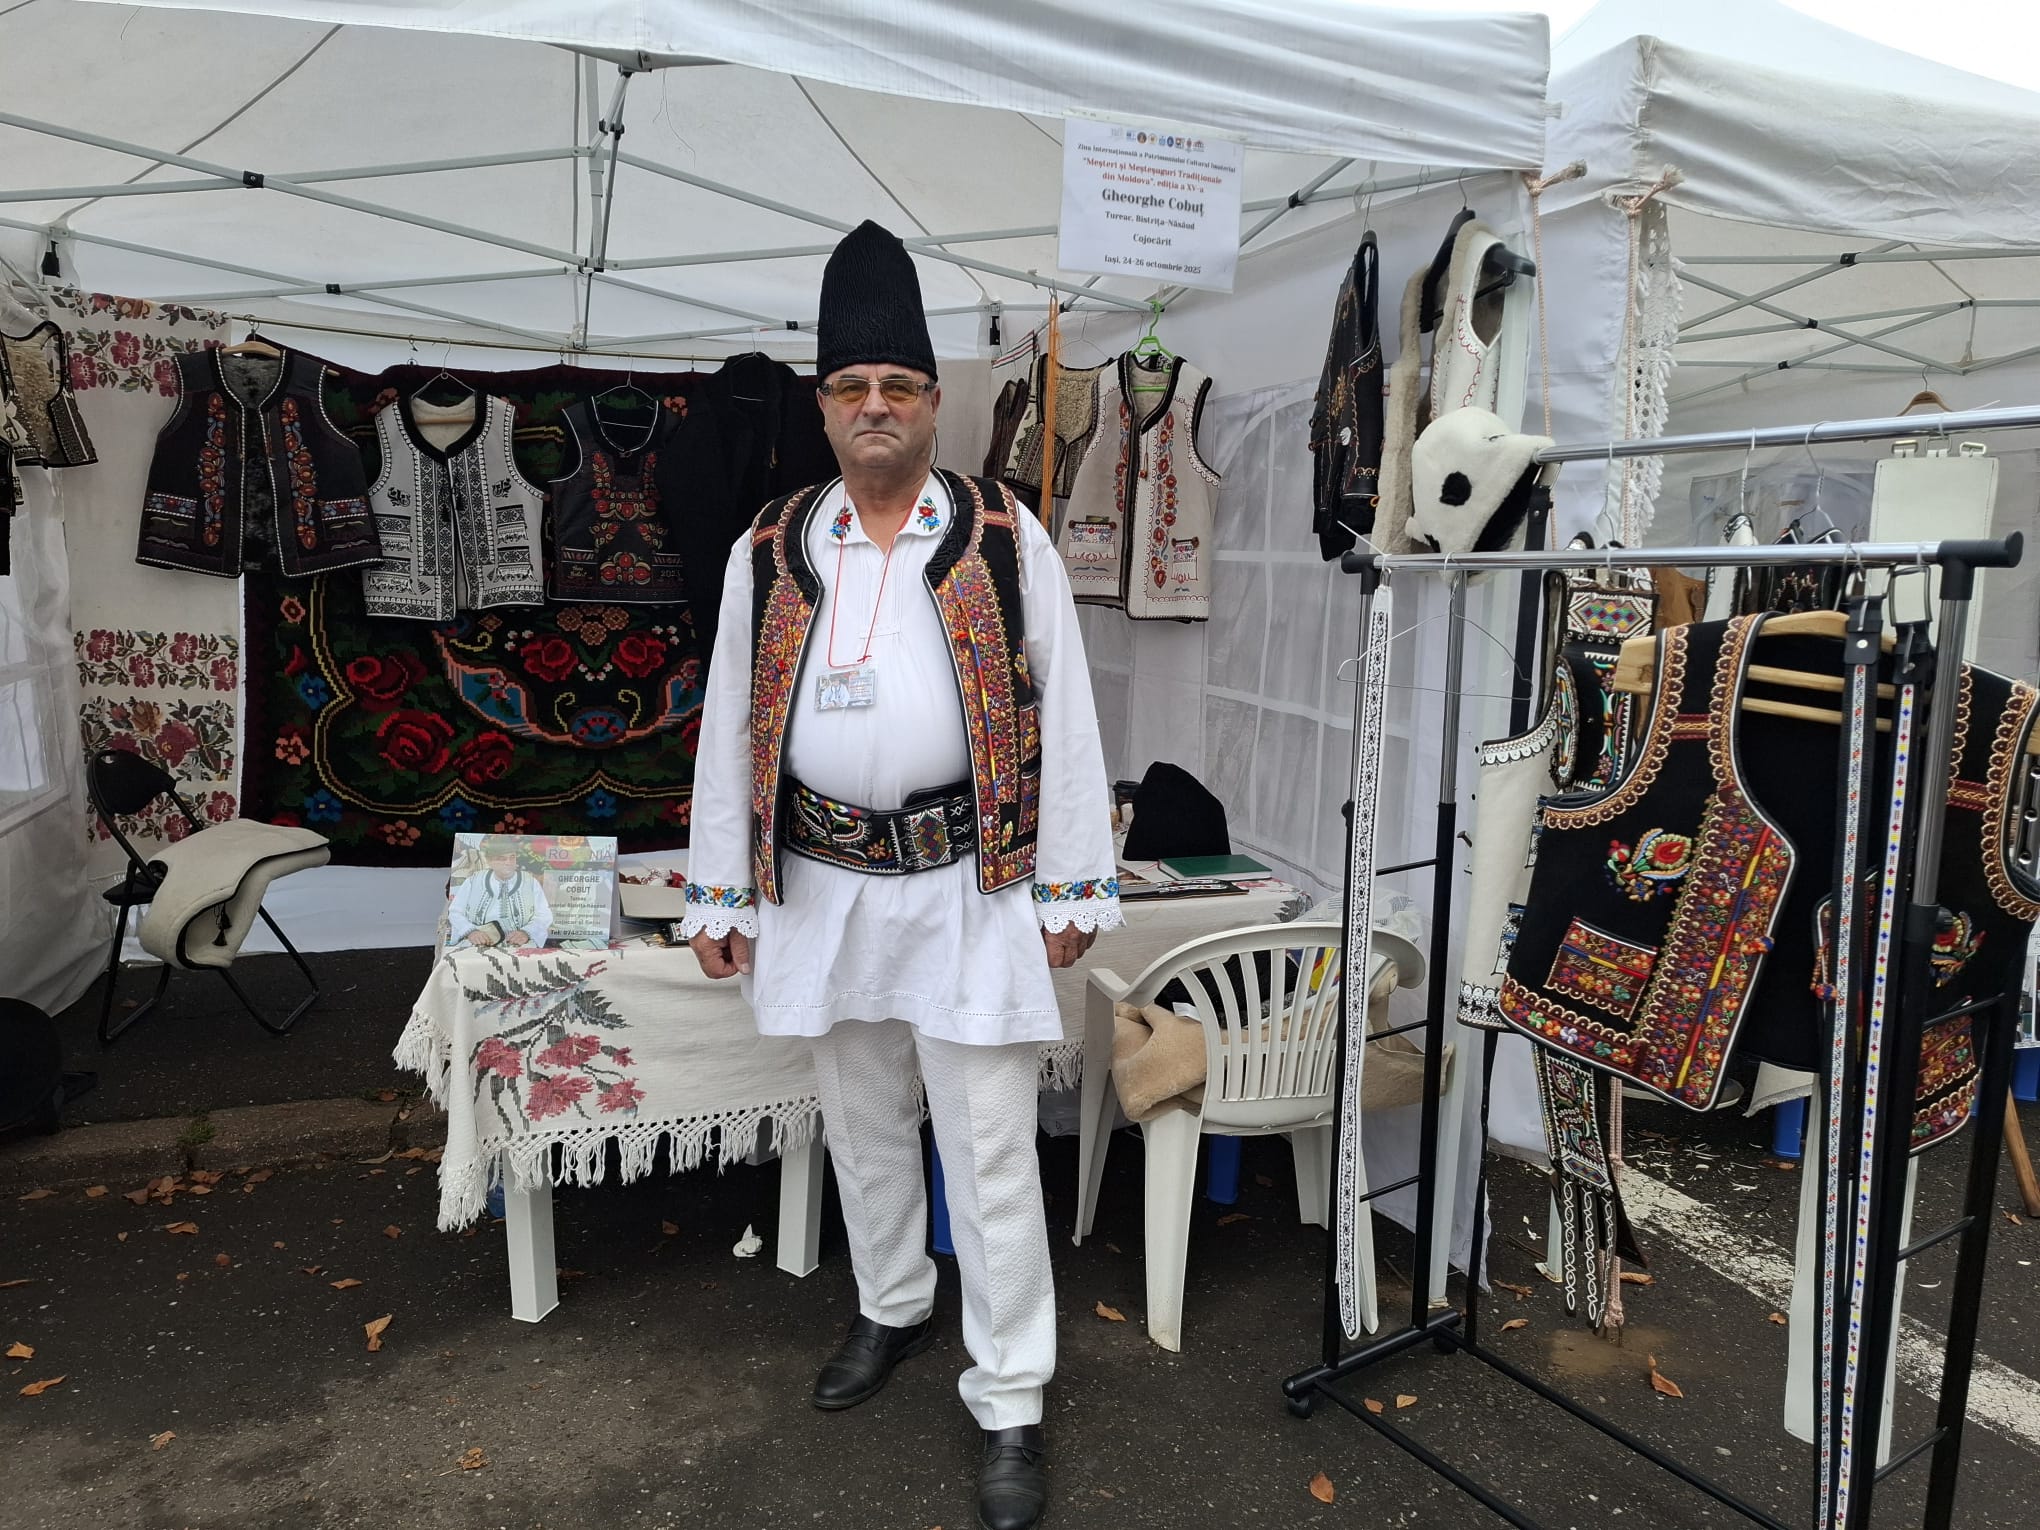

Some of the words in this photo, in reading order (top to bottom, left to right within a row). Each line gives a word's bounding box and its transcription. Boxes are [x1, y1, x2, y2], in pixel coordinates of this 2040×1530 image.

[1102, 172, 1116, 181] din
[1186, 183, 1204, 193] XV-a
[1102, 188, 1165, 208] Gheorghe
[1168, 197, 1205, 217] Cobuț
[1123, 256, 1144, 267] 24-26
[1146, 260, 1183, 272] octombrie
[1183, 265, 1201, 274] 2025
[558, 875, 601, 883] GHEORGHE
